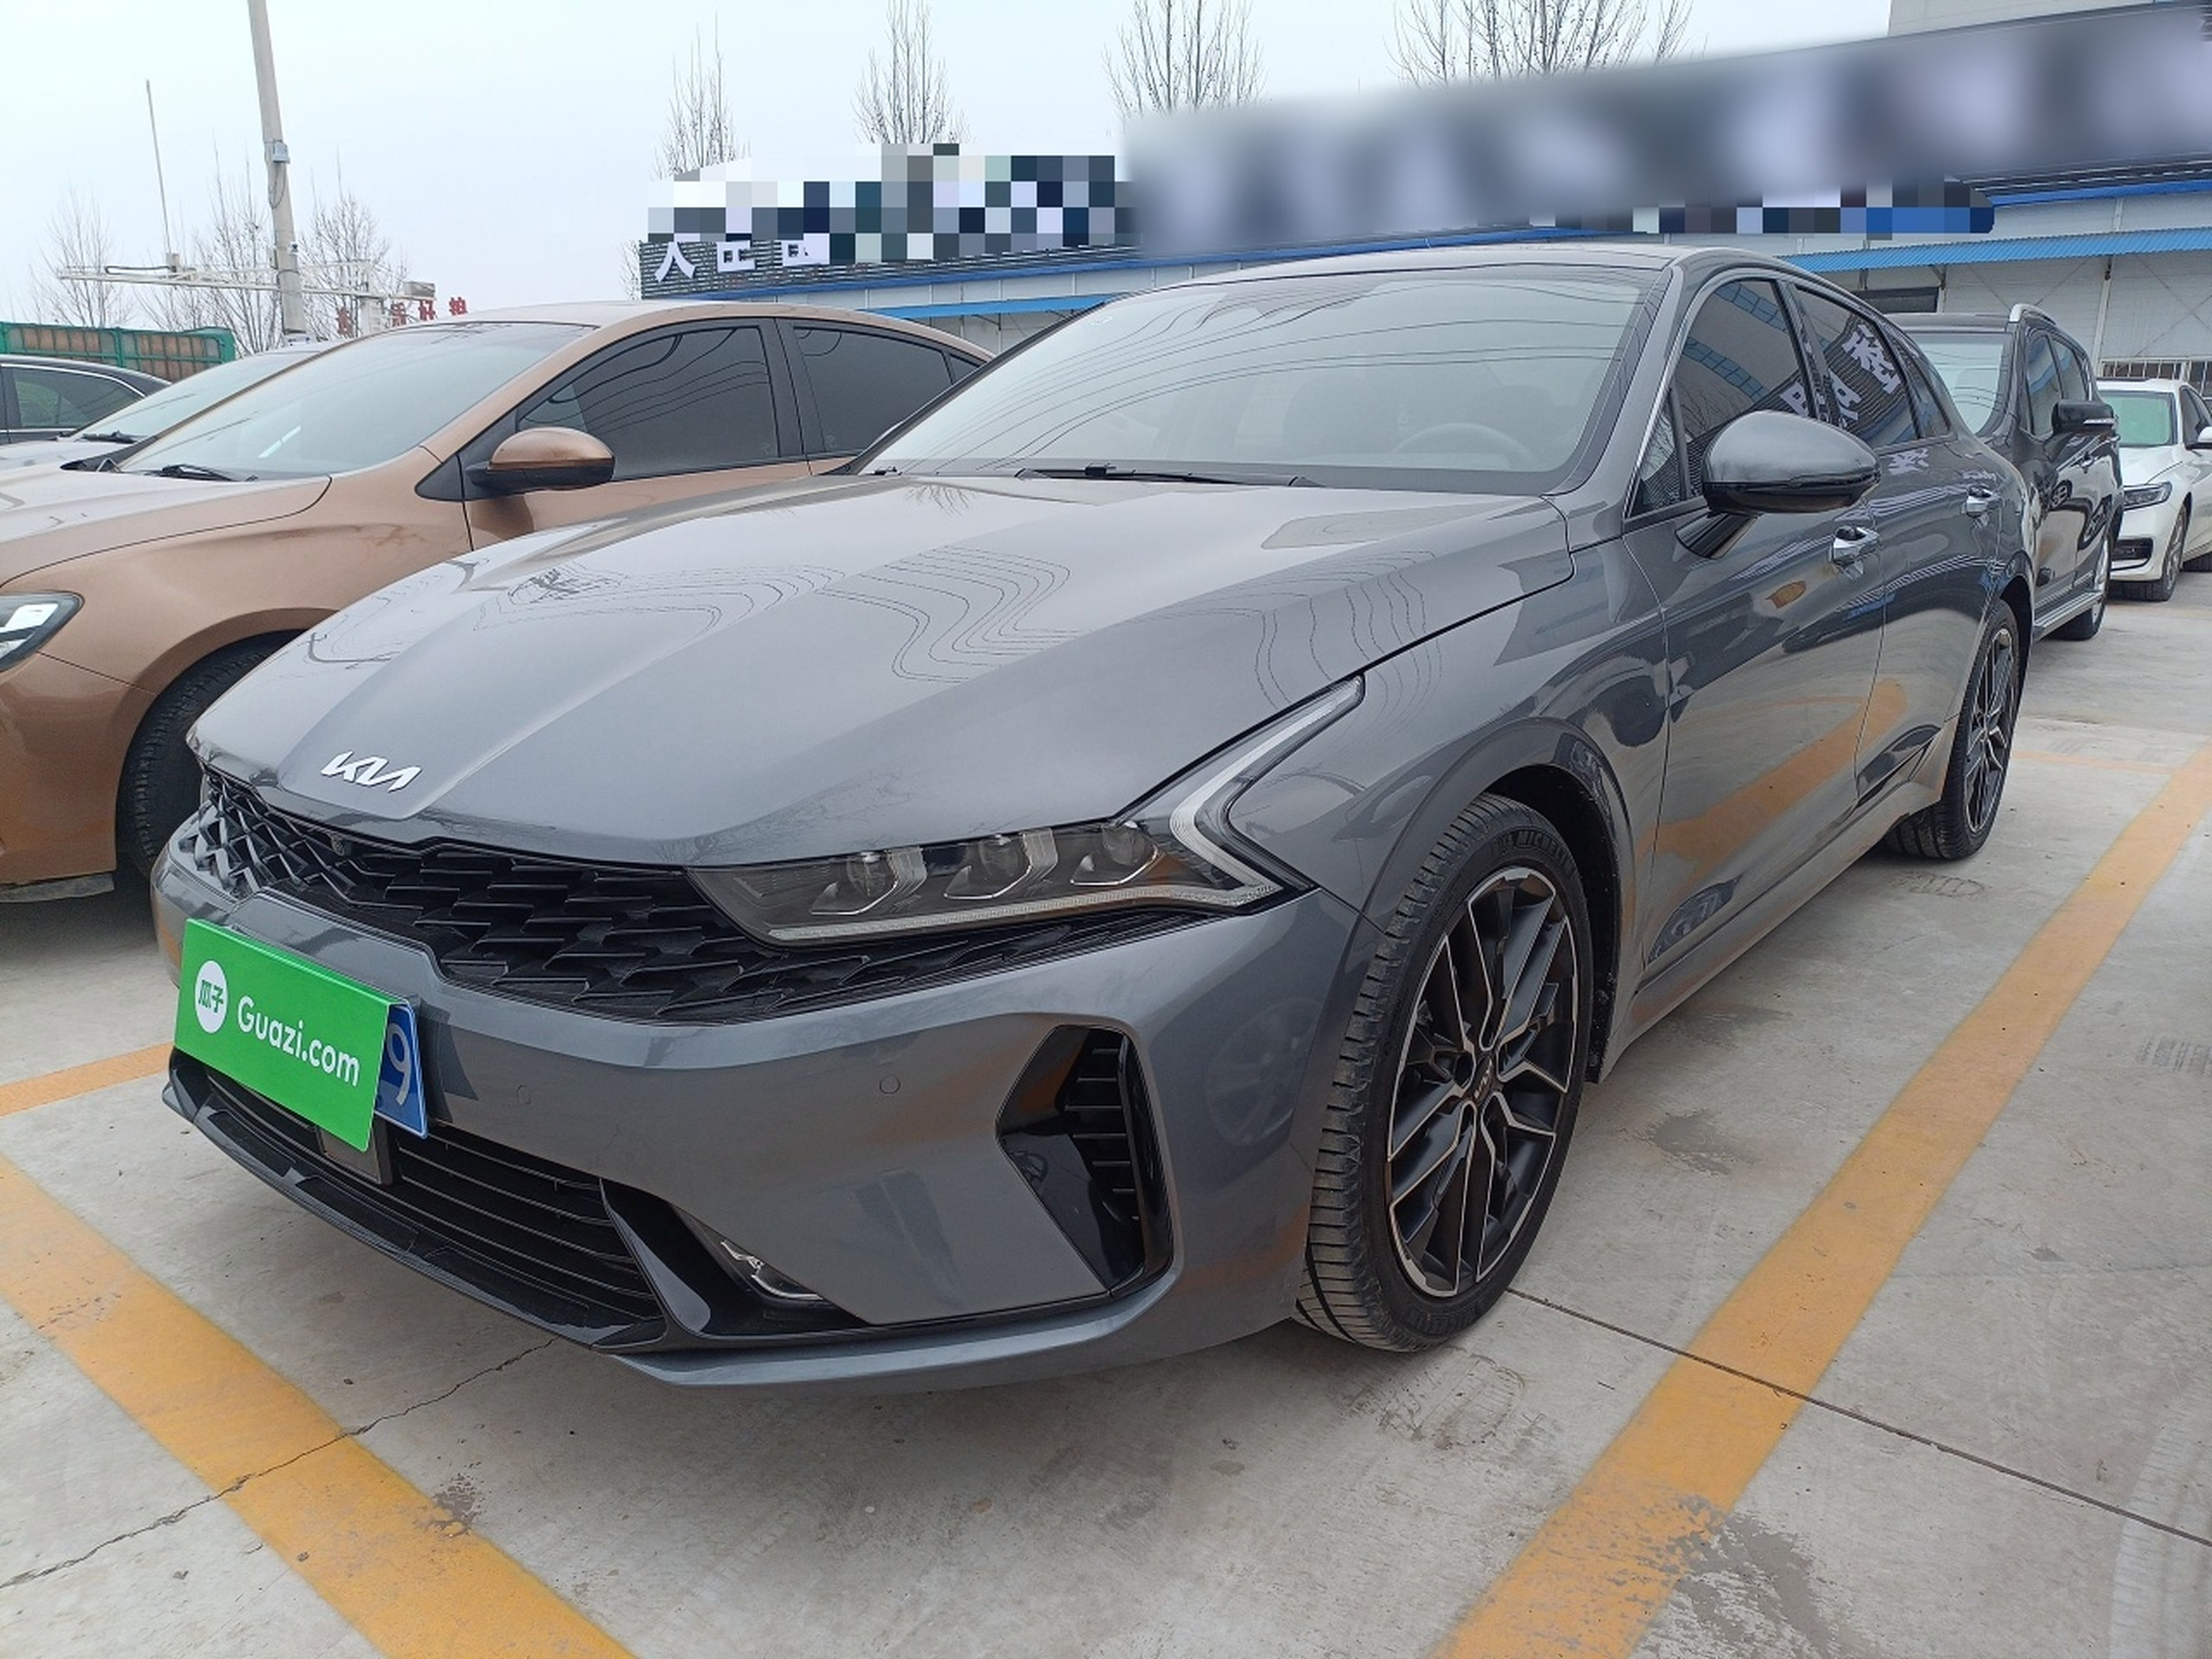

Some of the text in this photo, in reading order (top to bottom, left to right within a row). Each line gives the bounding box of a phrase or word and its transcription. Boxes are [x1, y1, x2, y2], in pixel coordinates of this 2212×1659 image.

[320, 750, 422, 793] KIA
[198, 979, 224, 1013] 瓜子
[237, 995, 360, 1087] Guazi.com
